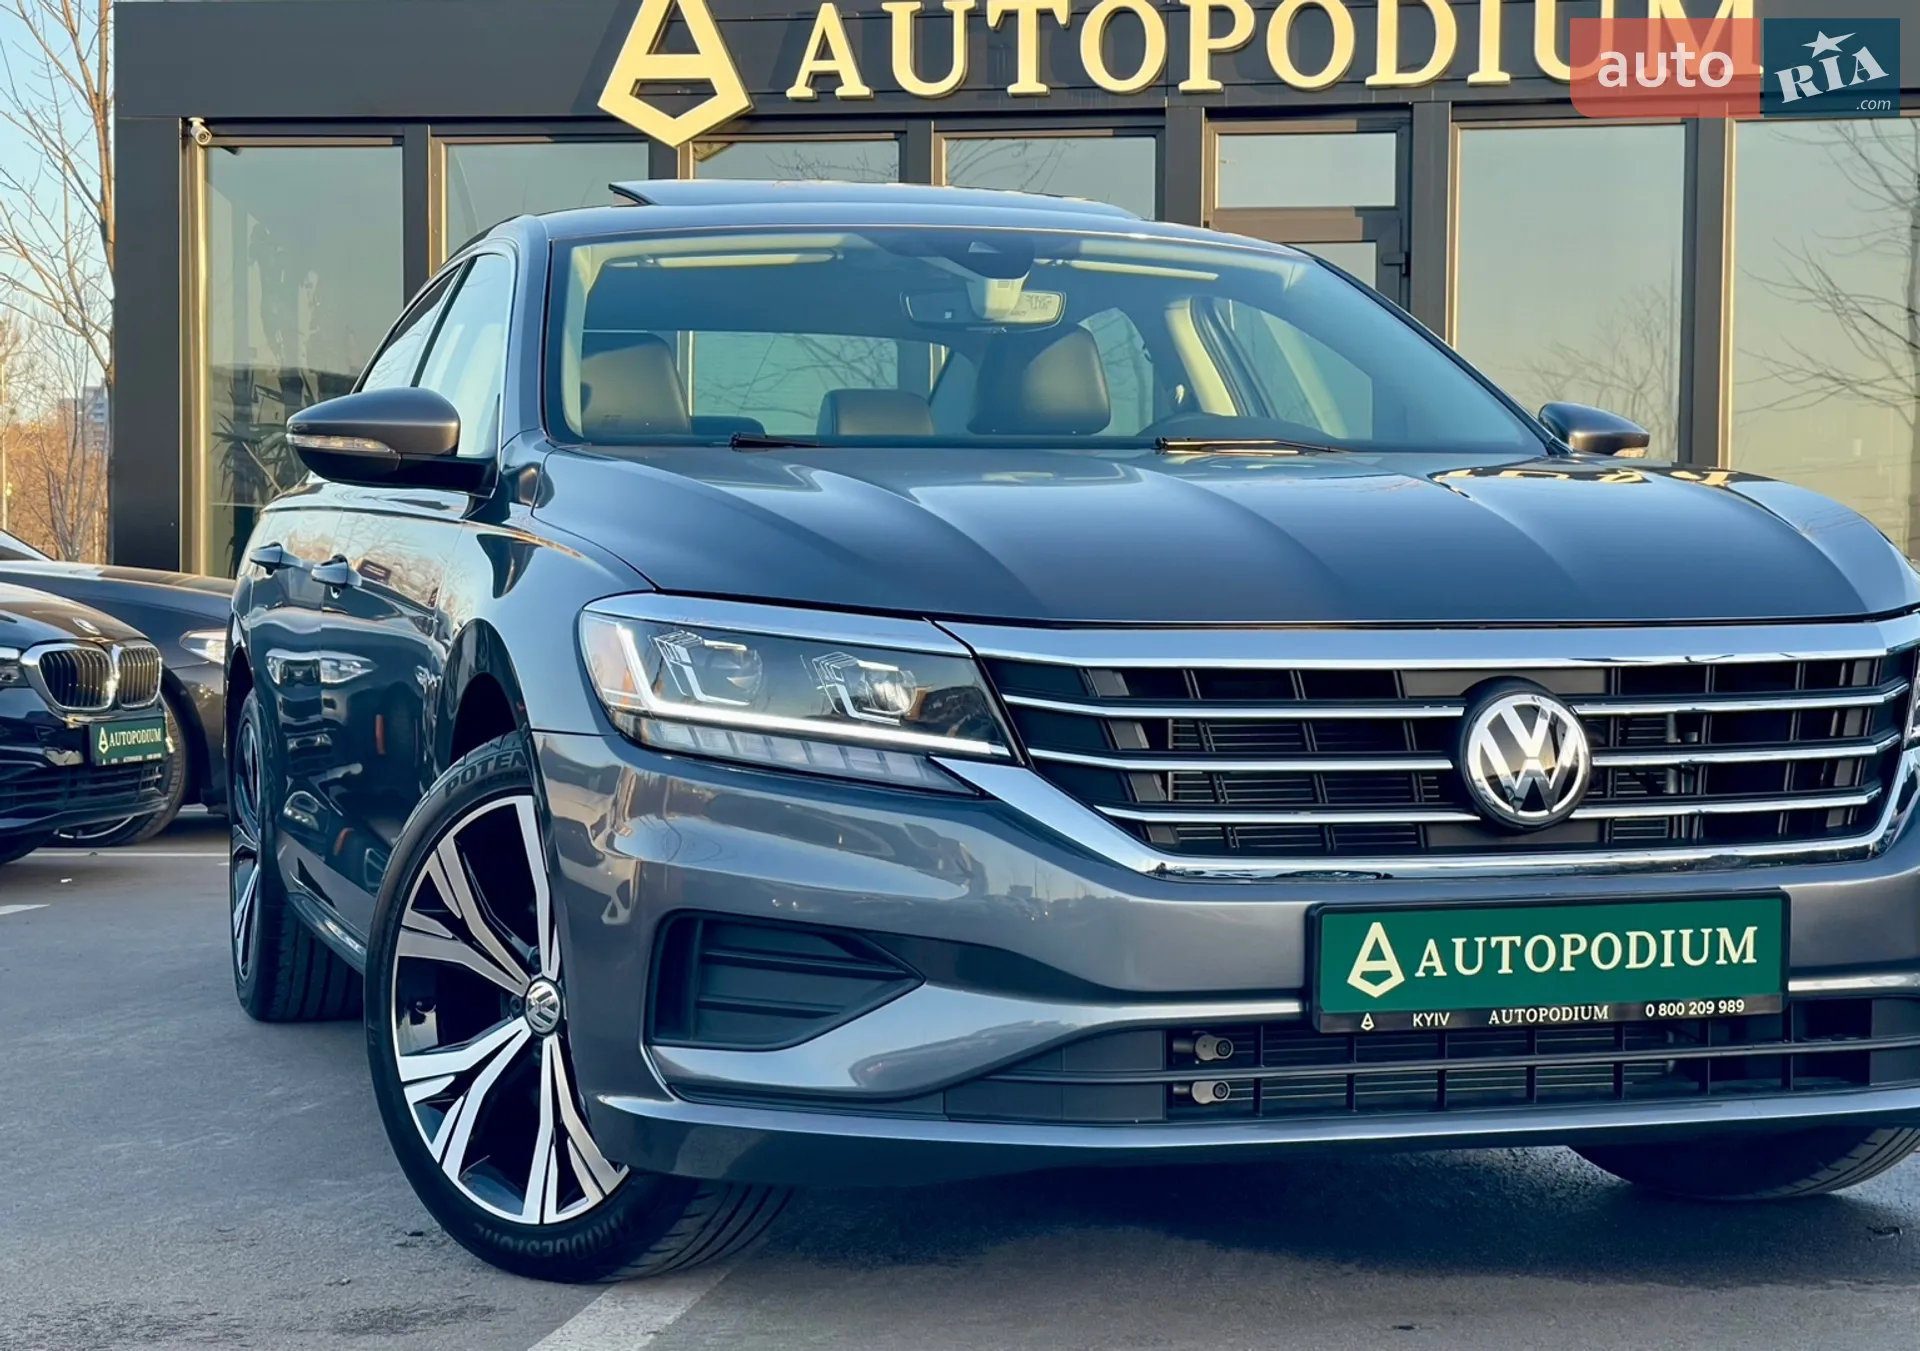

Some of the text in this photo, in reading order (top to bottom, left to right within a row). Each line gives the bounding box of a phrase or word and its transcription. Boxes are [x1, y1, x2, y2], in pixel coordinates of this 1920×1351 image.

[786, 0, 1763, 99] AUTOPODIUM
[109, 728, 162, 747] AUTOPODIUM
[1414, 926, 1758, 977] AUTOPODIUM
[1412, 998, 1745, 1028] KYIV AUTOPODIUM 0 800 209 989
